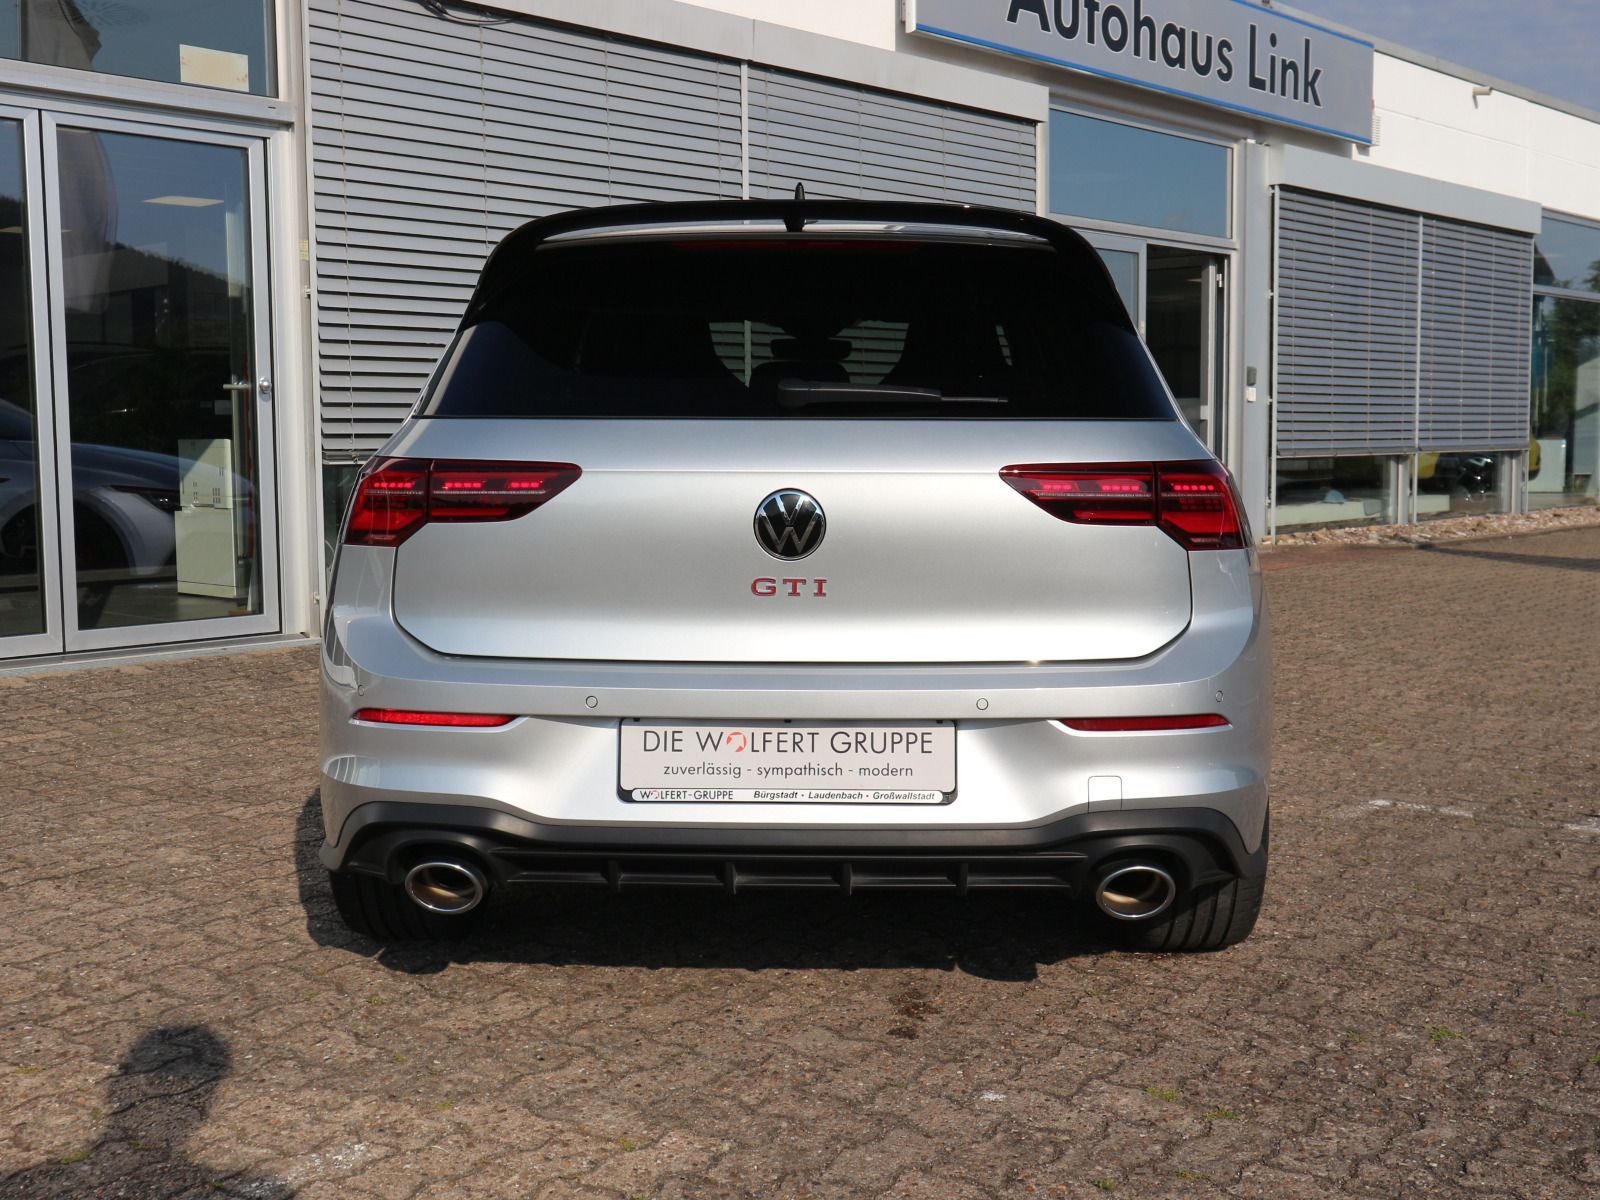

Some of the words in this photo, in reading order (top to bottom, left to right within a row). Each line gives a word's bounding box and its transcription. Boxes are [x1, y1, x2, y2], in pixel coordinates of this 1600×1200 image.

[1248, 23, 1323, 107] Link
[751, 577, 827, 597] GTI
[643, 730, 683, 752] DIE
[830, 731, 933, 754] GRUPPE
[663, 761, 742, 778] zuverlässig
[757, 762, 843, 779] sympathisch
[858, 763, 913, 777] modern
[753, 790, 798, 800] Bürgstadt
[808, 791, 863, 800] Laudenbach
[873, 791, 935, 801] Großwallstadt
